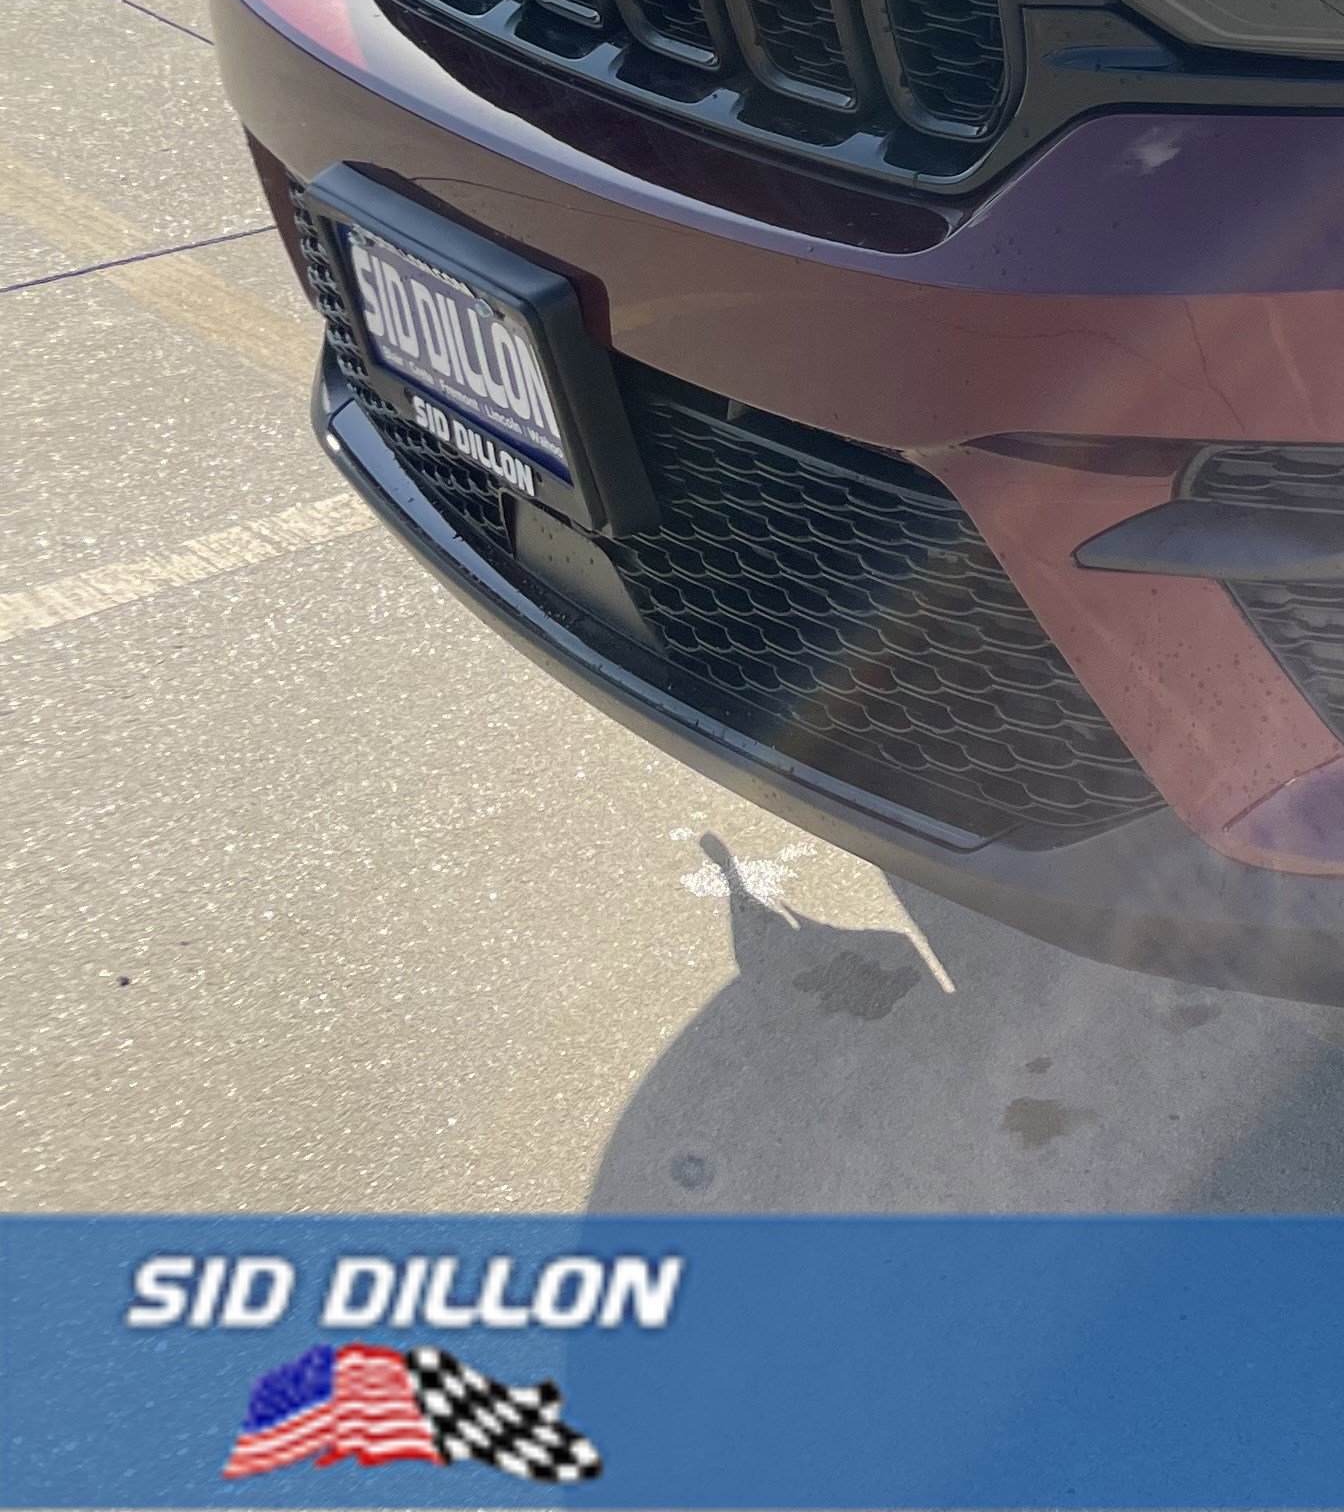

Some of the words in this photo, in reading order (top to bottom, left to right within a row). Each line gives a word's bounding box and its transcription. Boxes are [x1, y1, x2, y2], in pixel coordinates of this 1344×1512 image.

[351, 243, 421, 360] SID
[410, 278, 562, 439] DILLON
[412, 393, 450, 442] SID
[452, 419, 535, 497] DILLON
